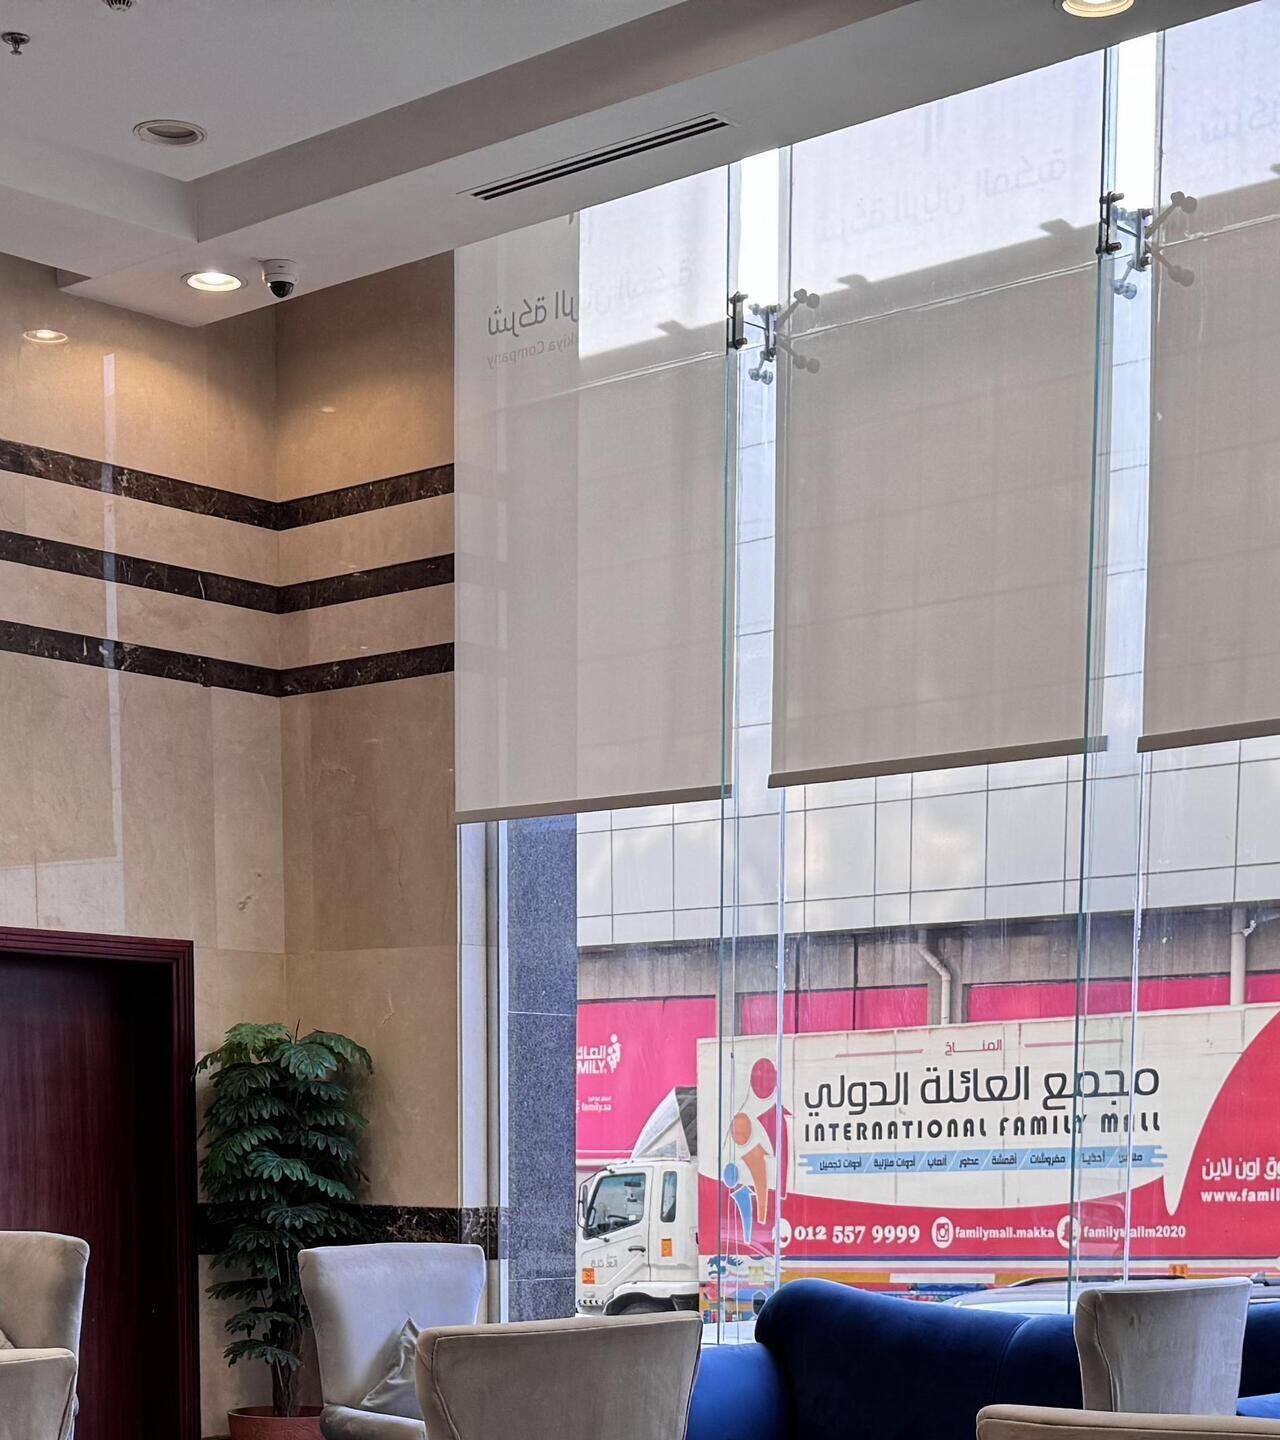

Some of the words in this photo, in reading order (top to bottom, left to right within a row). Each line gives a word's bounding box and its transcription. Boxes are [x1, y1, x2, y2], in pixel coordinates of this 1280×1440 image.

[803, 1071, 909, 1117] الدولي
[920, 1065, 1030, 1104] العائلة
[1042, 1067, 1160, 1111] مجمع
[804, 1117, 987, 1142] INTERNATIONAL
[999, 1113, 1088, 1137] FAMILY
[1100, 1111, 1161, 1133] MALL
[819, 1160, 842, 1171] تجميل
[842, 1158, 862, 1171] أدوات
[959, 1156, 980, 1168] عطور
[991, 1152, 1018, 1166] أقمشة
[1029, 1151, 1066, 1167] مفروشات
[1201, 1157, 1232, 1182] لاين
[1234, 1156, 1261, 1180] اون
[793, 1225, 828, 1241] 012
[831, 1225, 866, 1245] 557
[870, 1224, 921, 1245] 9999
[954, 1226, 1055, 1241] familymall.makka
